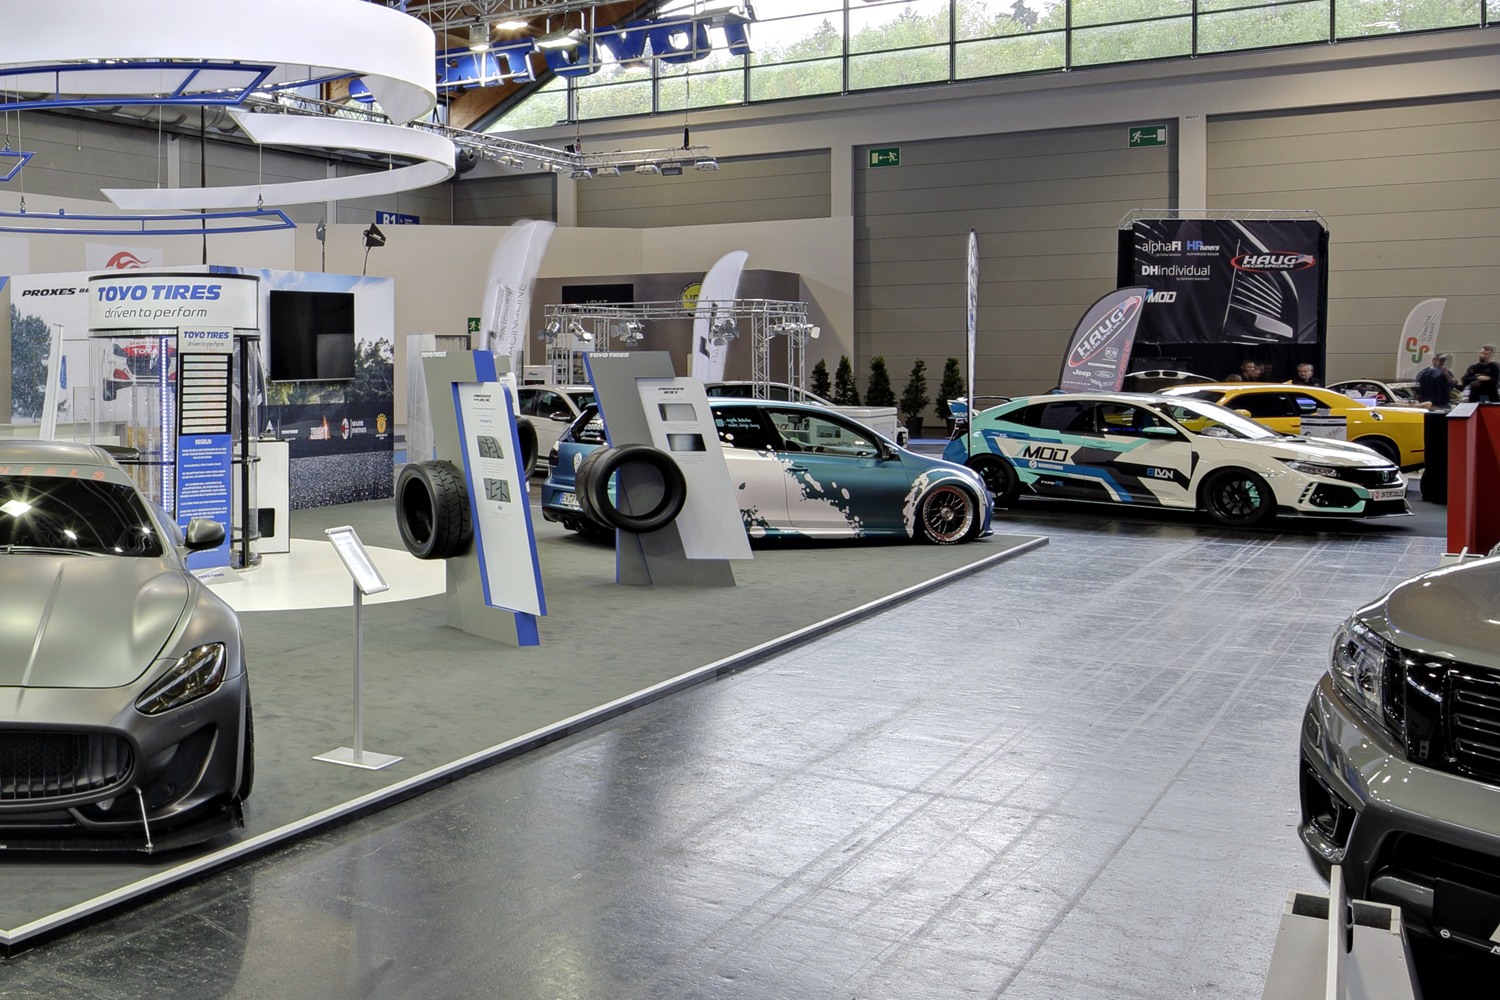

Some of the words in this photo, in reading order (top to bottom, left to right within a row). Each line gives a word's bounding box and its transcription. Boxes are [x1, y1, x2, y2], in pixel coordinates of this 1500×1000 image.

[1141, 240, 1182, 254] alphaFI
[1243, 255, 1297, 264] HAUG
[1141, 264, 1210, 276] DHindividual
[21, 287, 77, 297] PROXES
[98, 285, 147, 301] TOYO
[151, 285, 222, 300] TIRES
[105, 306, 135, 318] driven
[138, 308, 151, 318] to
[153, 306, 207, 320] perform
[183, 331, 205, 339] TOYO
[206, 331, 230, 339] TIRES
[1077, 308, 1124, 357] HAUG
[1072, 369, 1092, 377] Jeep
[1015, 441, 1069, 462] 7MOD
